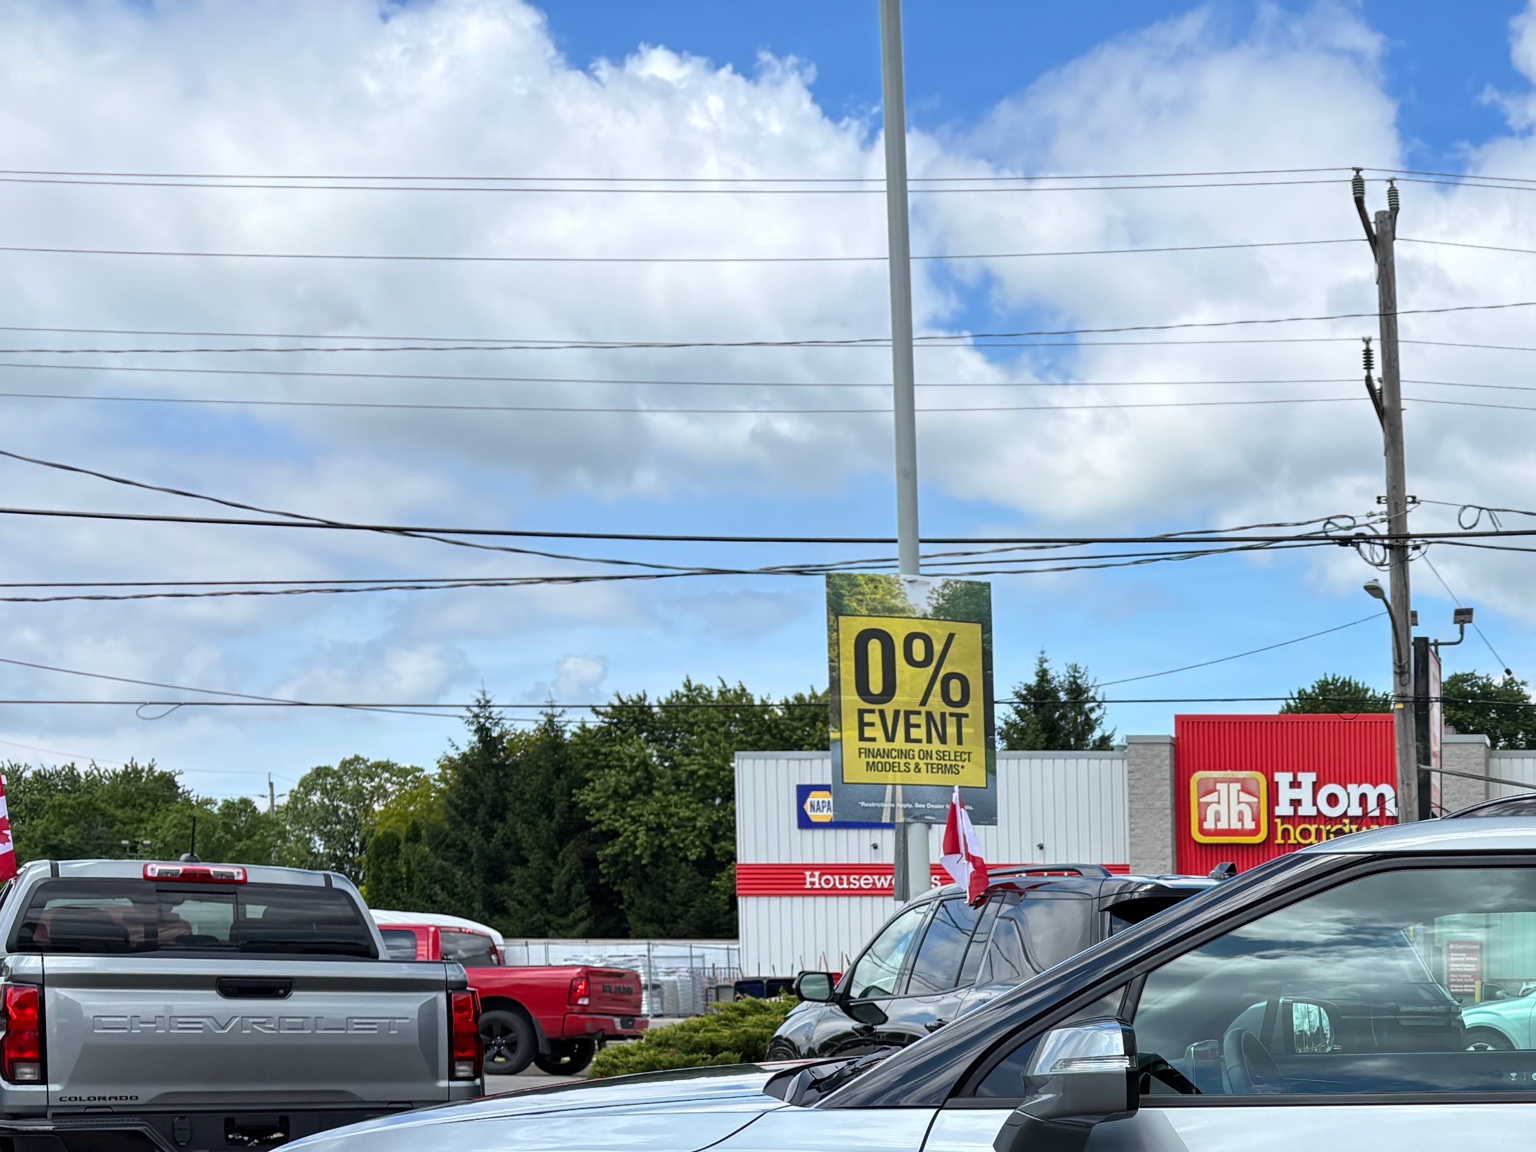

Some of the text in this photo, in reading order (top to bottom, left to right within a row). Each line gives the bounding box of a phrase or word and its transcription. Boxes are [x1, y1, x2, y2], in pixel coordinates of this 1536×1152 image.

[854, 628, 971, 709] 0%
[857, 708, 970, 746] EVENT
[858, 747, 973, 763] FINANCING ON SELECT
[866, 760, 911, 774] MODELS
[914, 762, 921, 774] &
[1273, 771, 1399, 818] Hom
[809, 799, 833, 814] NAPA
[804, 870, 942, 890] Housews
[92, 1014, 411, 1034] CHEVROLET
[58, 1094, 140, 1103] COLORADO
